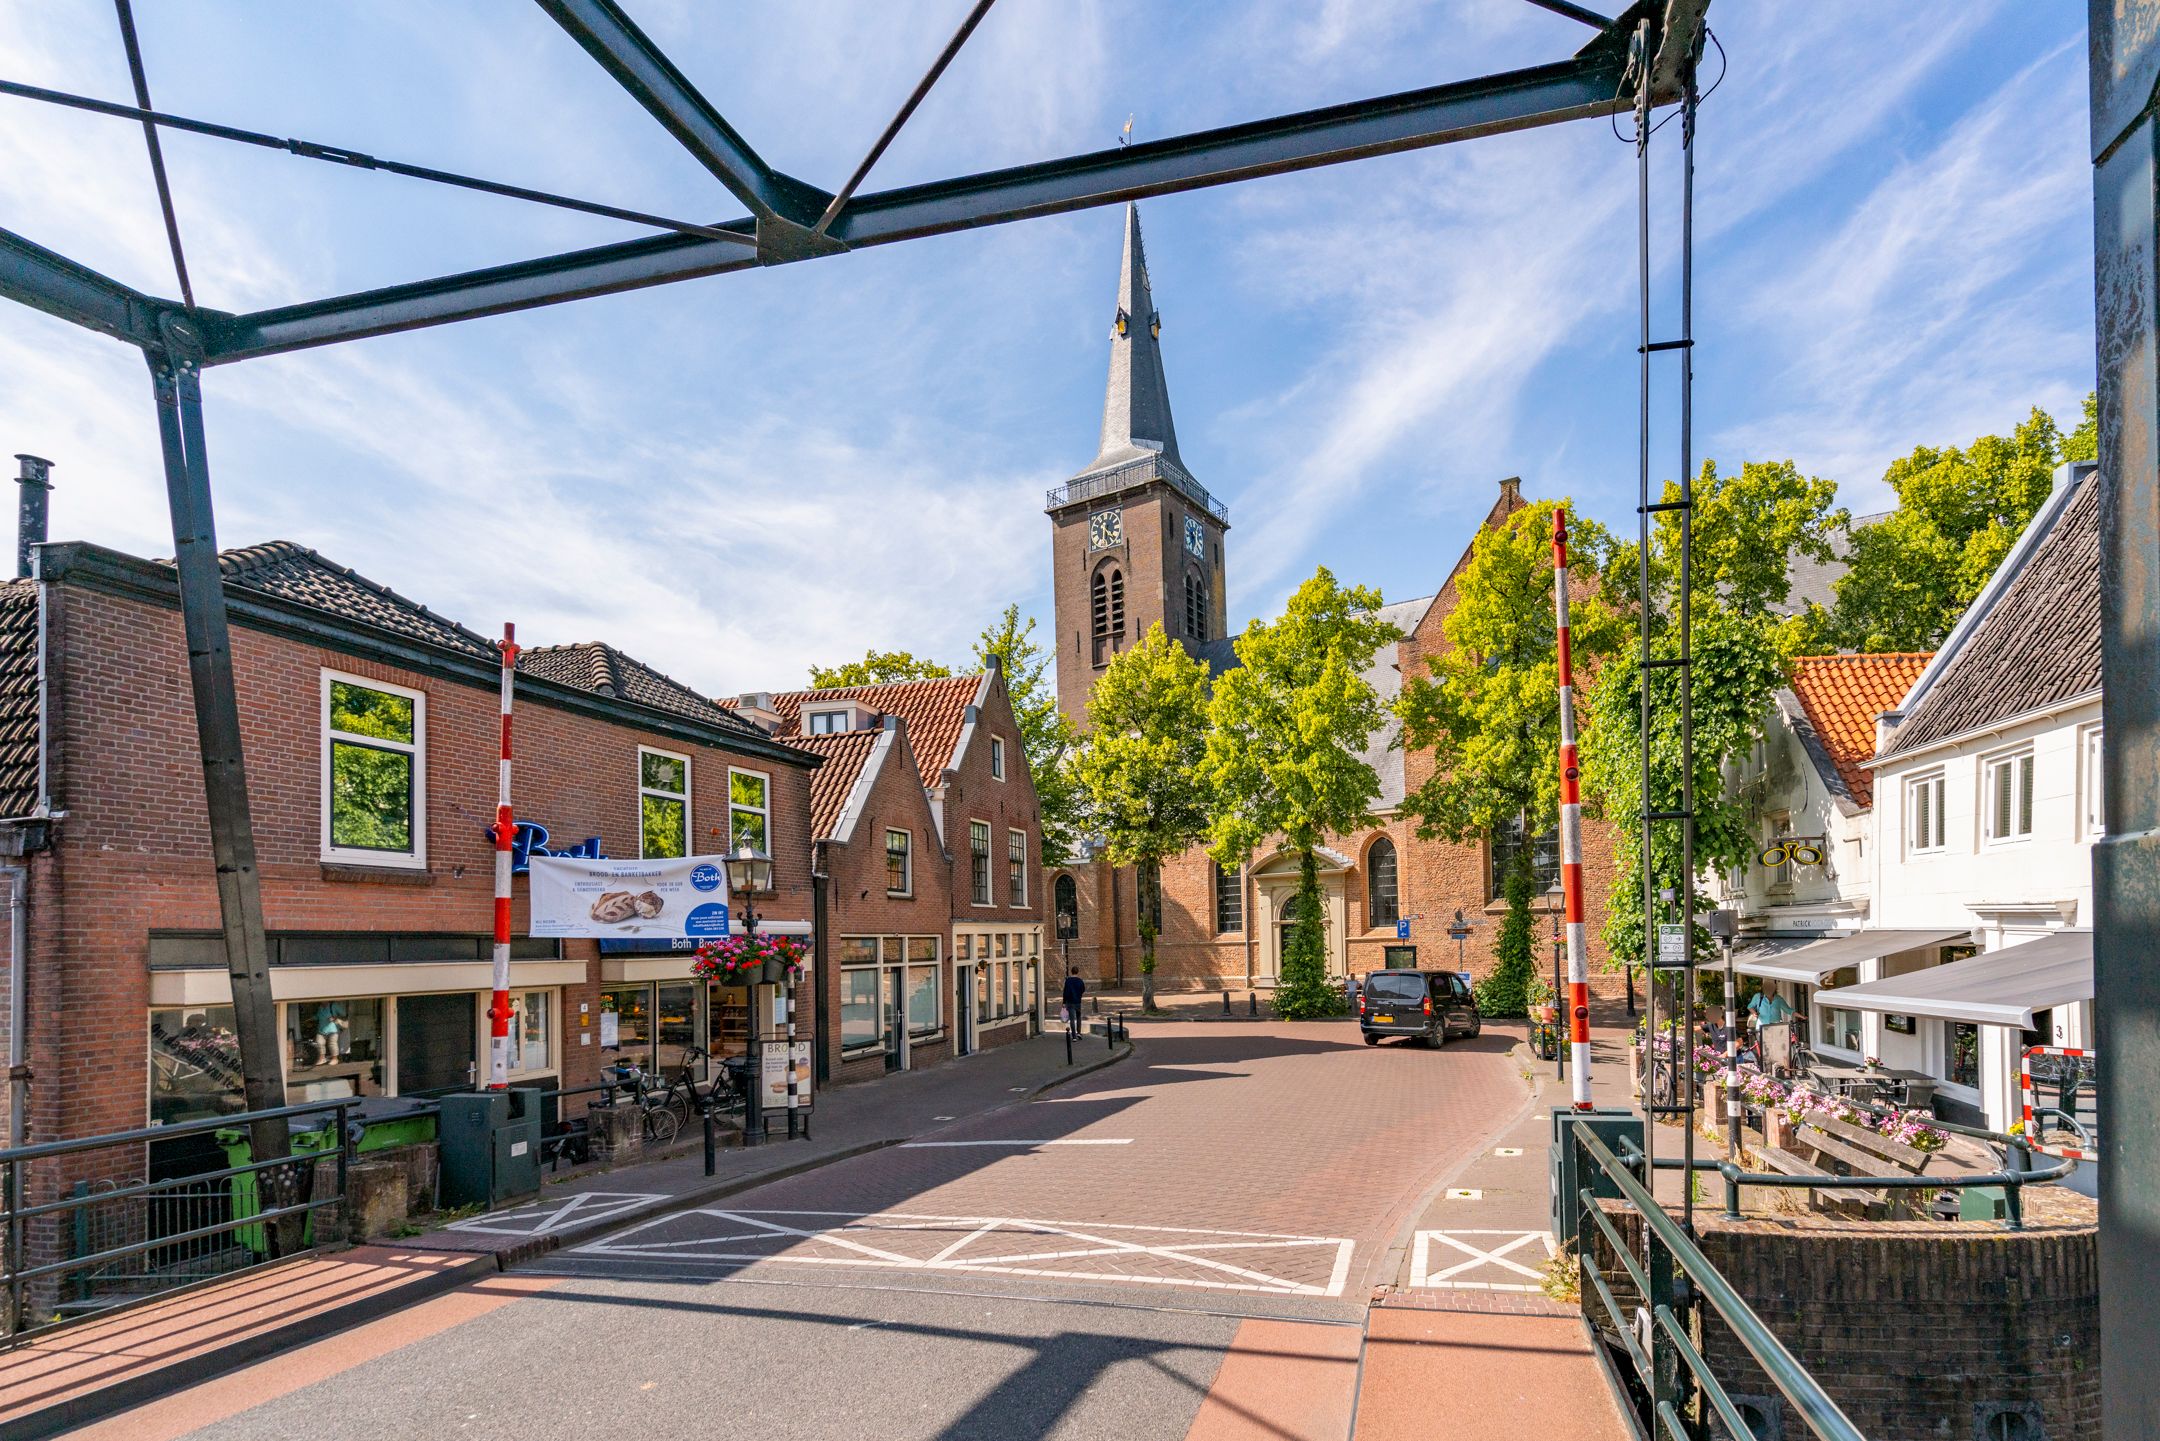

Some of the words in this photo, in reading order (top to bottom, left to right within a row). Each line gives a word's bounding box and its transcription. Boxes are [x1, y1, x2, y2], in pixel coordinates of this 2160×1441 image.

[692, 871, 720, 883] Both
[1399, 921, 1407, 931] P
[671, 938, 692, 949] Both
[2056, 1025, 2063, 1039] 3
[768, 1043, 806, 1053] BROD
